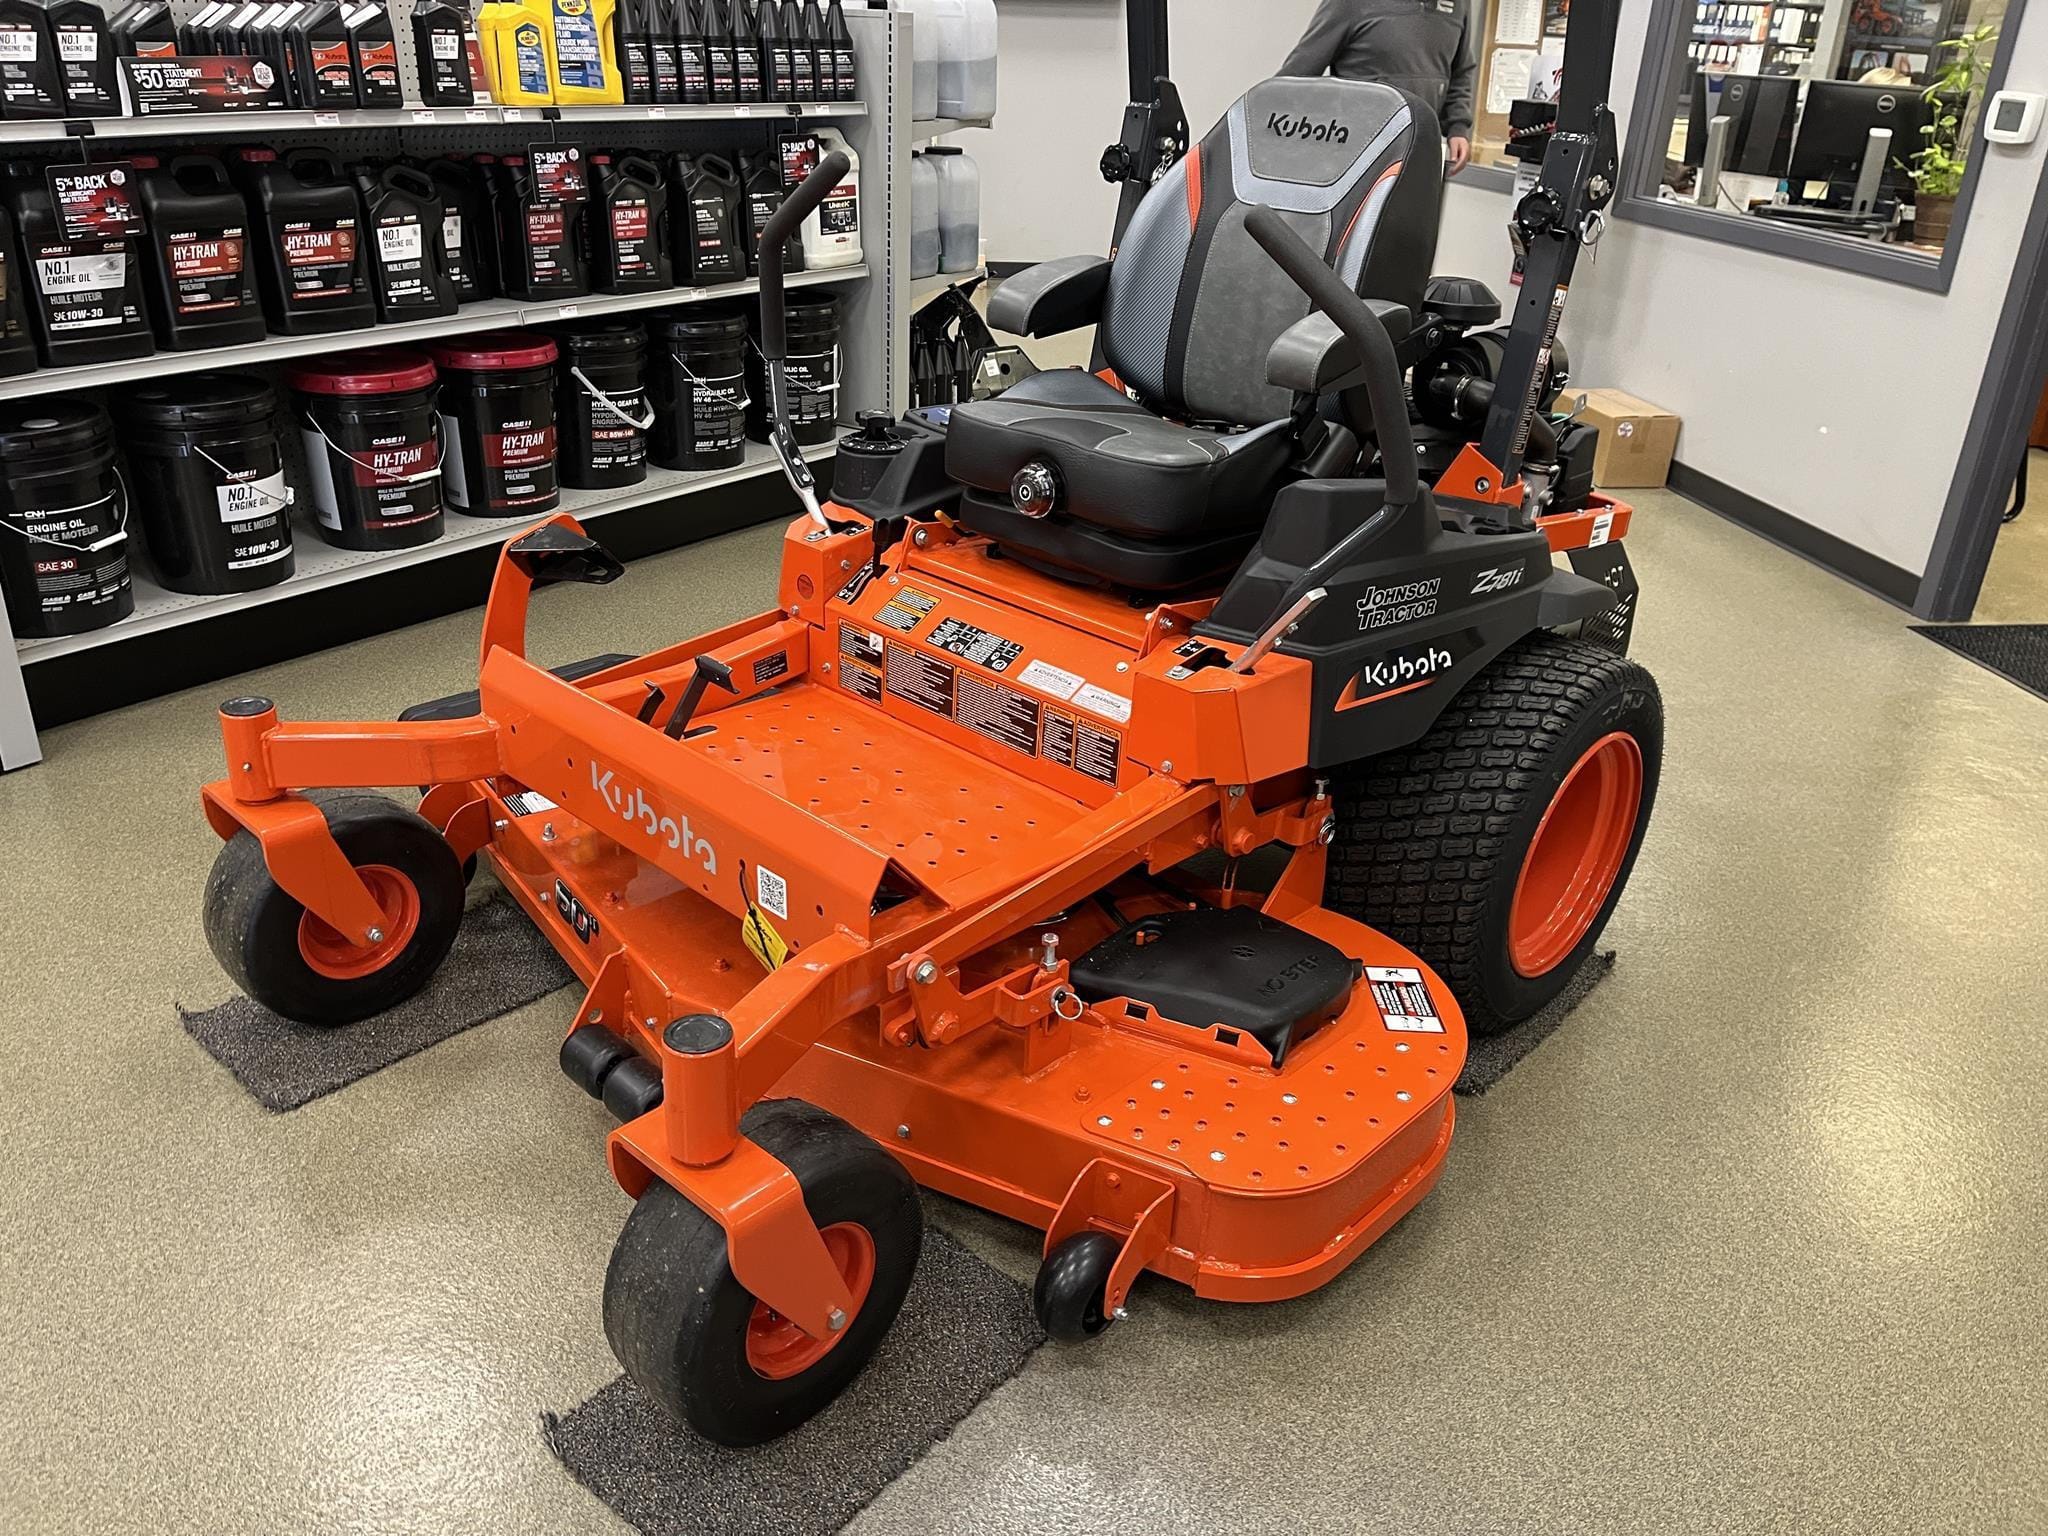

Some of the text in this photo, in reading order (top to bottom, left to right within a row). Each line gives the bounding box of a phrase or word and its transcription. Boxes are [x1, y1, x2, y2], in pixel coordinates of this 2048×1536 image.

[61, 34, 79, 44] NO.1
[133, 69, 163, 88] $50
[164, 68, 202, 78] STATEMENT
[166, 78, 190, 88] CREDIT
[1267, 112, 1350, 144] Kubota
[546, 151, 567, 163] BACK
[55, 174, 108, 191] 5% BACK
[529, 214, 555, 225] HY-TRAN
[615, 210, 640, 220] HY-TRAN
[287, 233, 332, 249] HY-TRAN
[382, 229, 400, 241] NO.1
[173, 243, 219, 261] HY-TRAN
[384, 240, 404, 249] ENGINE
[45, 260, 71, 277] NO.1
[47, 273, 91, 286] ENGINE OIL
[50, 295, 72, 304] HUILE
[372, 437, 398, 445] CASE
[502, 431, 545, 449] HY-TRAN
[594, 431, 608, 439] SAE
[373, 447, 422, 468] HY-TRAN
[503, 448, 529, 456] PREMIUM
[226, 471, 249, 479] CASE
[374, 466, 404, 475] PREMIUM
[227, 486, 253, 503] NO.1
[378, 491, 407, 501] PREMIUM
[229, 496, 270, 512] ENGINE OIL
[24, 510, 46, 518] CNH
[26, 518, 86, 534] ENGINE OIL
[61, 524, 99, 540] MOTEUR
[231, 515, 278, 534] HUILE MOTEUR
[247, 539, 280, 556] 10W-30
[38, 560, 74, 572] SAE 30
[1357, 577, 1441, 611] JOHNSON
[1357, 598, 1438, 630] TRACTOR
[1364, 647, 1453, 687] Kubota
[1084, 719, 1120, 739] ADVERTENCIA
[591, 759, 717, 876] Kubota
[1280, 953, 1320, 981] STEP
